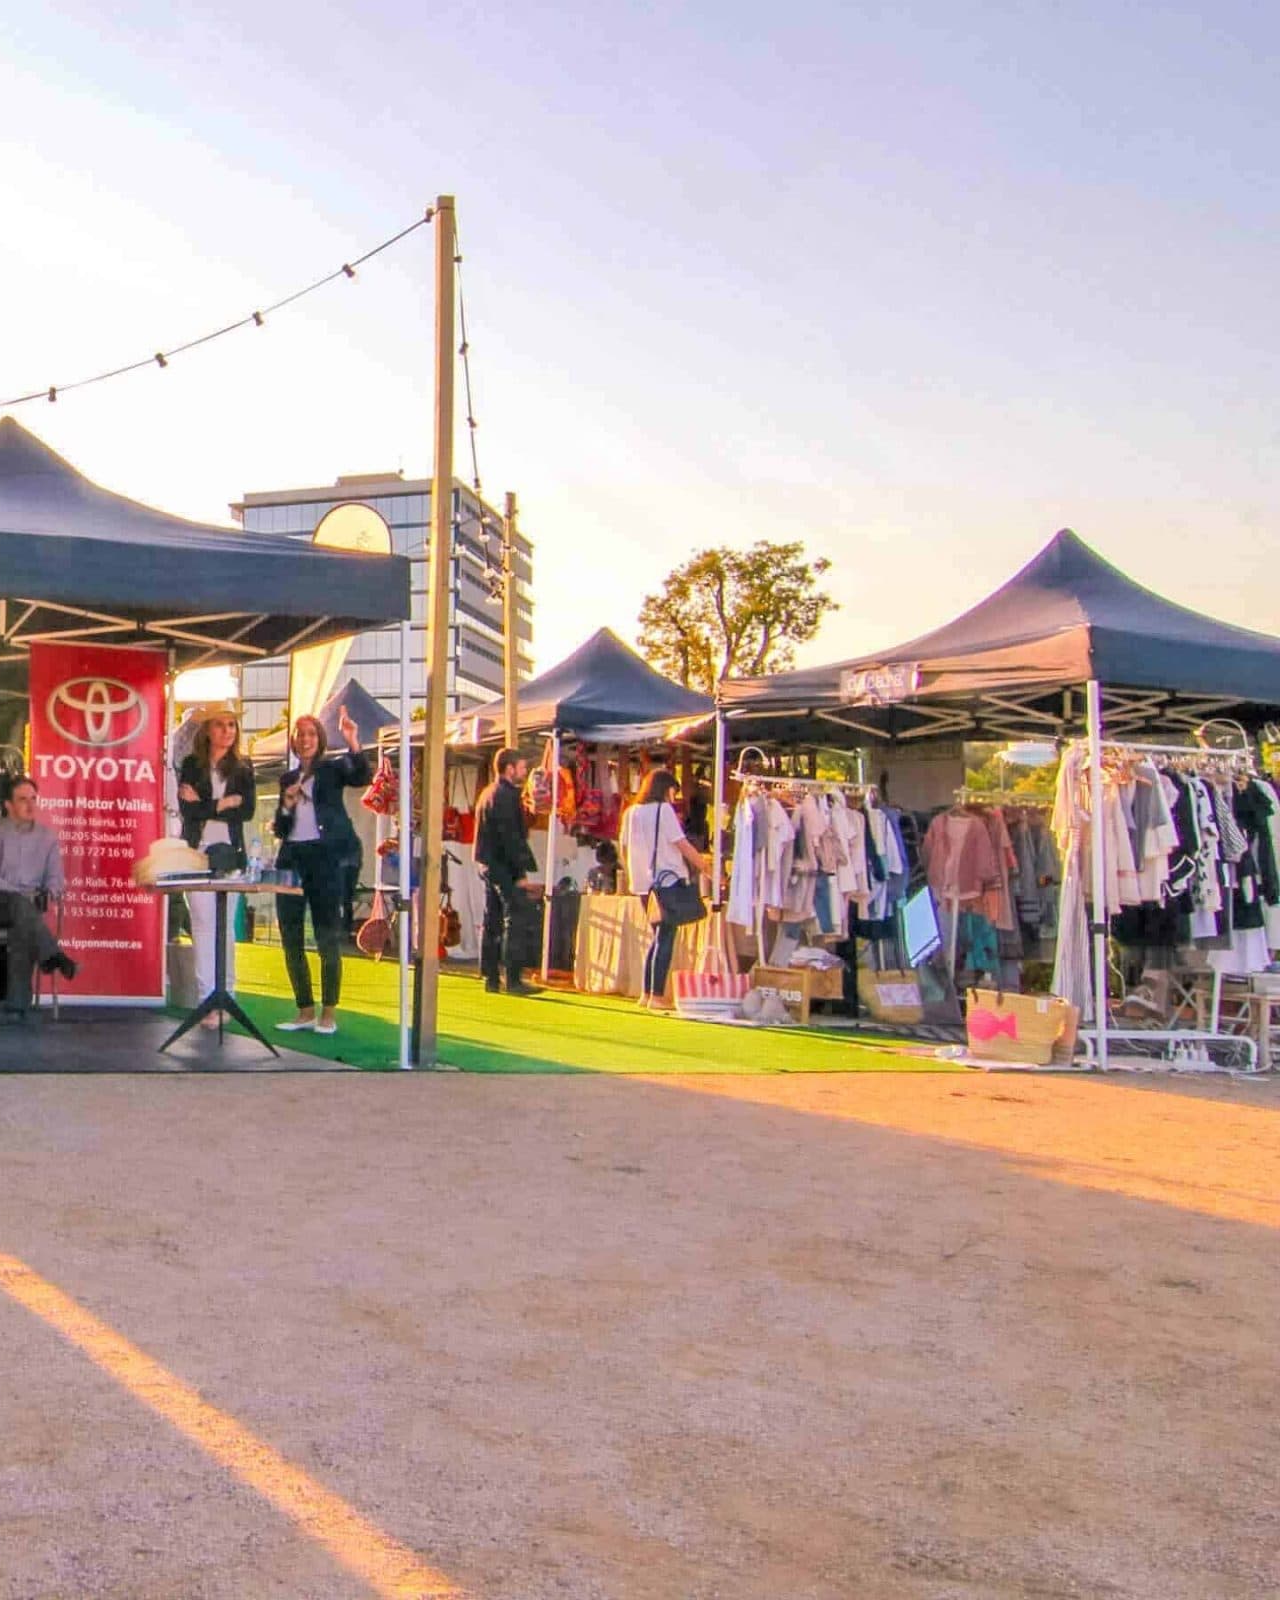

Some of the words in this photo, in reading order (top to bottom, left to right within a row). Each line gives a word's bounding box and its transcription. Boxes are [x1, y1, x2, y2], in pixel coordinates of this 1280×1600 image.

[34, 754, 156, 784] TOYOTA
[76, 796, 115, 810] Motor
[91, 831, 132, 843] Sabadell
[72, 845, 85, 857] 93
[80, 892, 108, 904] Cugat
[110, 893, 125, 904] del
